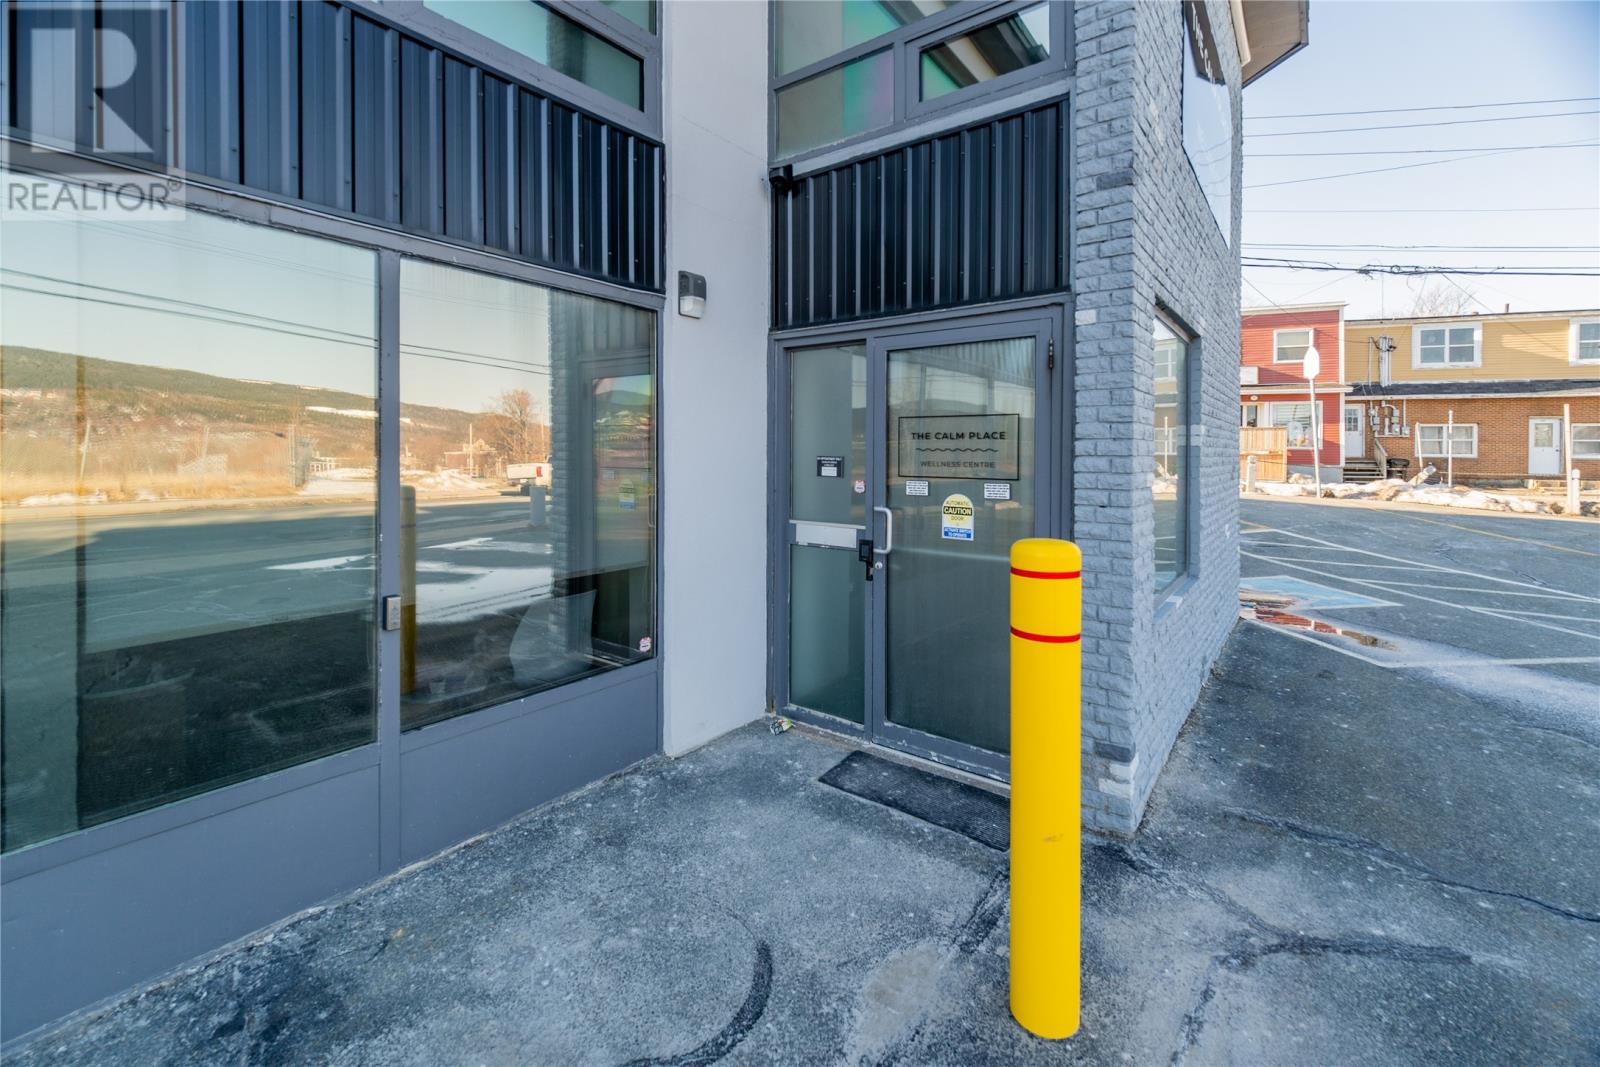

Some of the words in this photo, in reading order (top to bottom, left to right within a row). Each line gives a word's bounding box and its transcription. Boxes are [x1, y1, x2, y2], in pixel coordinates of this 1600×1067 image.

[911, 432, 931, 440] THE
[934, 431, 965, 440] CALM
[968, 431, 1006, 440] PLACE
[963, 461, 996, 469] CENTRE
[943, 507, 972, 515] CAUTION
